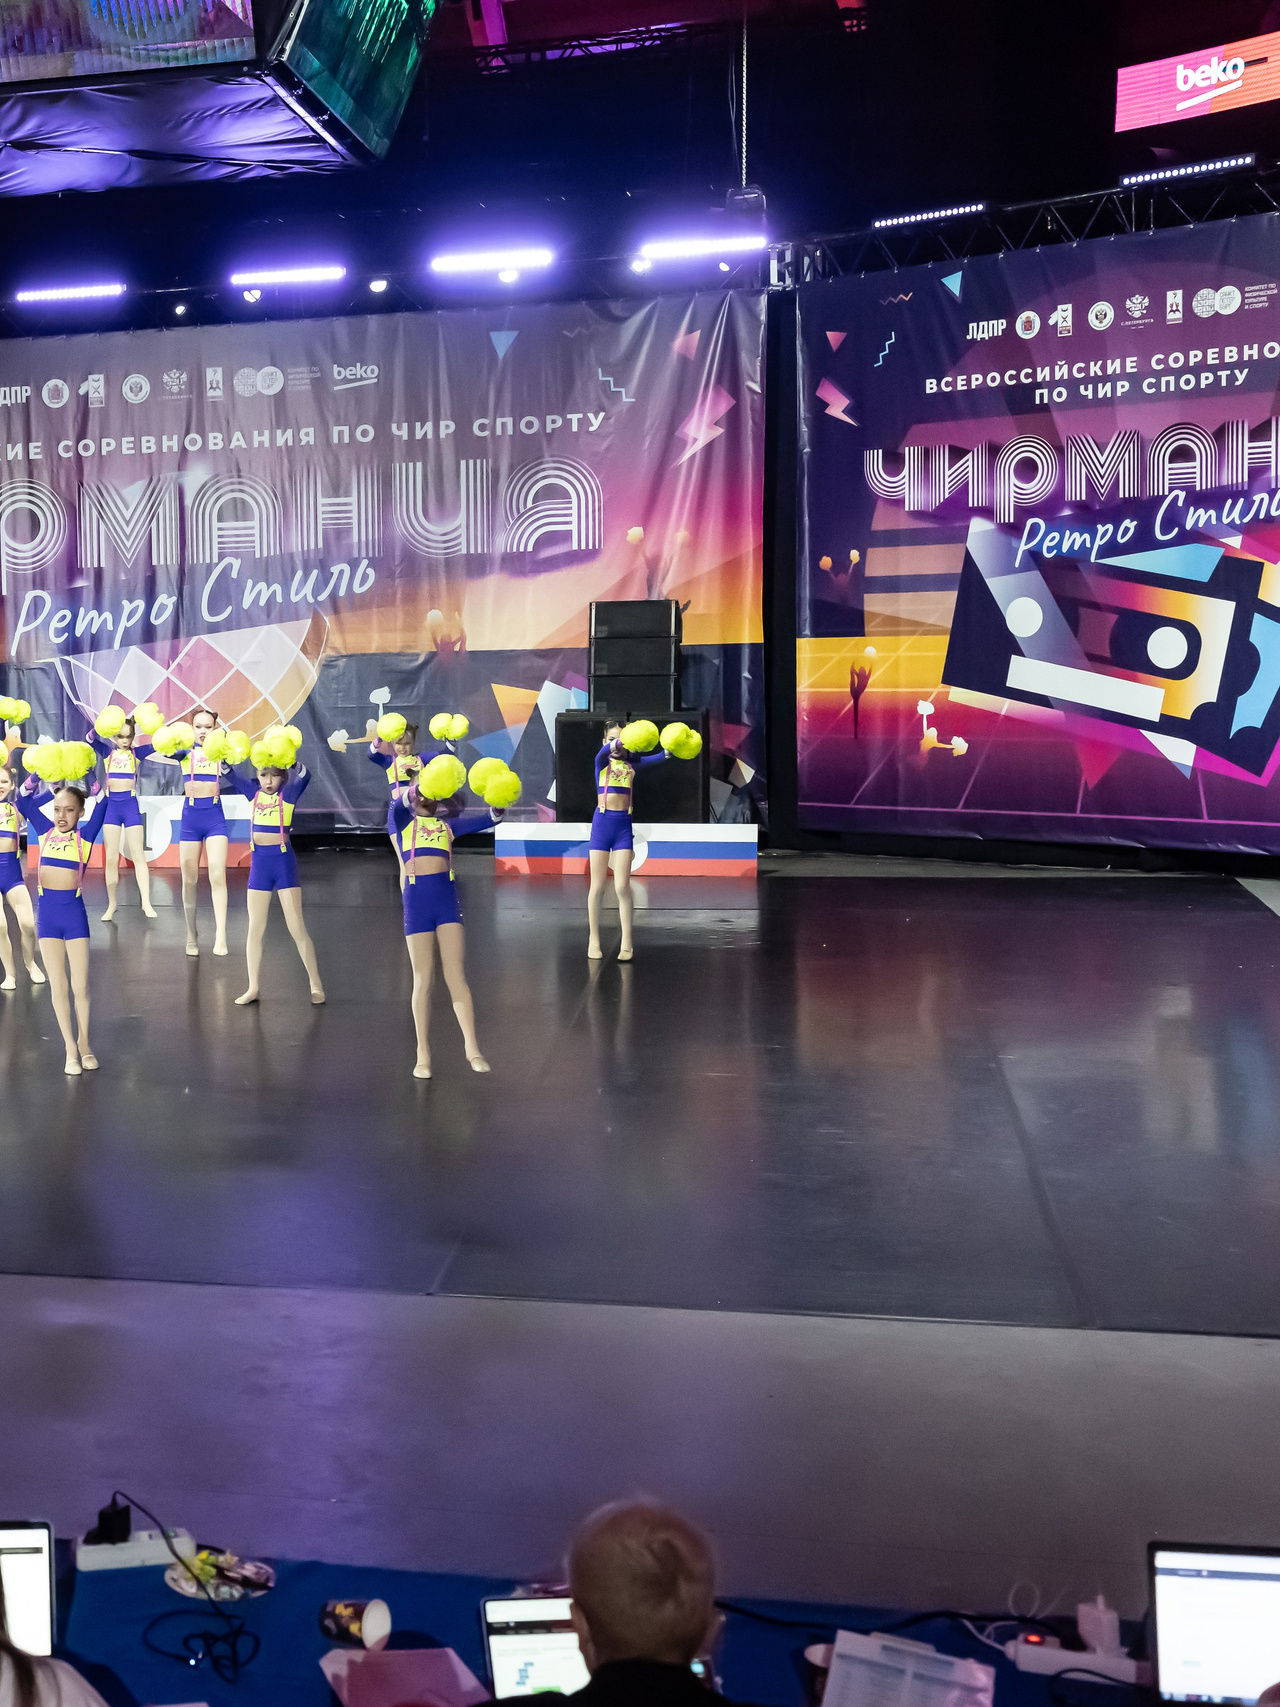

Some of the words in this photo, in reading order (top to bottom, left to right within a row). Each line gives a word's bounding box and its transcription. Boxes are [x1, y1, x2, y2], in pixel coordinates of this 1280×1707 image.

[1175, 56, 1246, 91] beko
[966, 319, 1007, 341] ЛДПР
[333, 363, 379, 380] beko
[925, 357, 1139, 394] ВСЕРОССИЙСКИЕ
[1034, 387, 1068, 405] ПО
[1079, 381, 1130, 400] ЧИР
[1142, 368, 1250, 395] СПОРТУ
[58, 426, 315, 458] СОРЕВНОВАНИЯ
[332, 423, 375, 444] ПО
[391, 418, 456, 440] ЧИР
[472, 412, 606, 438] СПОРТУ
[1014, 518, 1138, 568] Ретро
[10, 589, 177, 656] Ретро
[201, 557, 376, 623] Стиль
